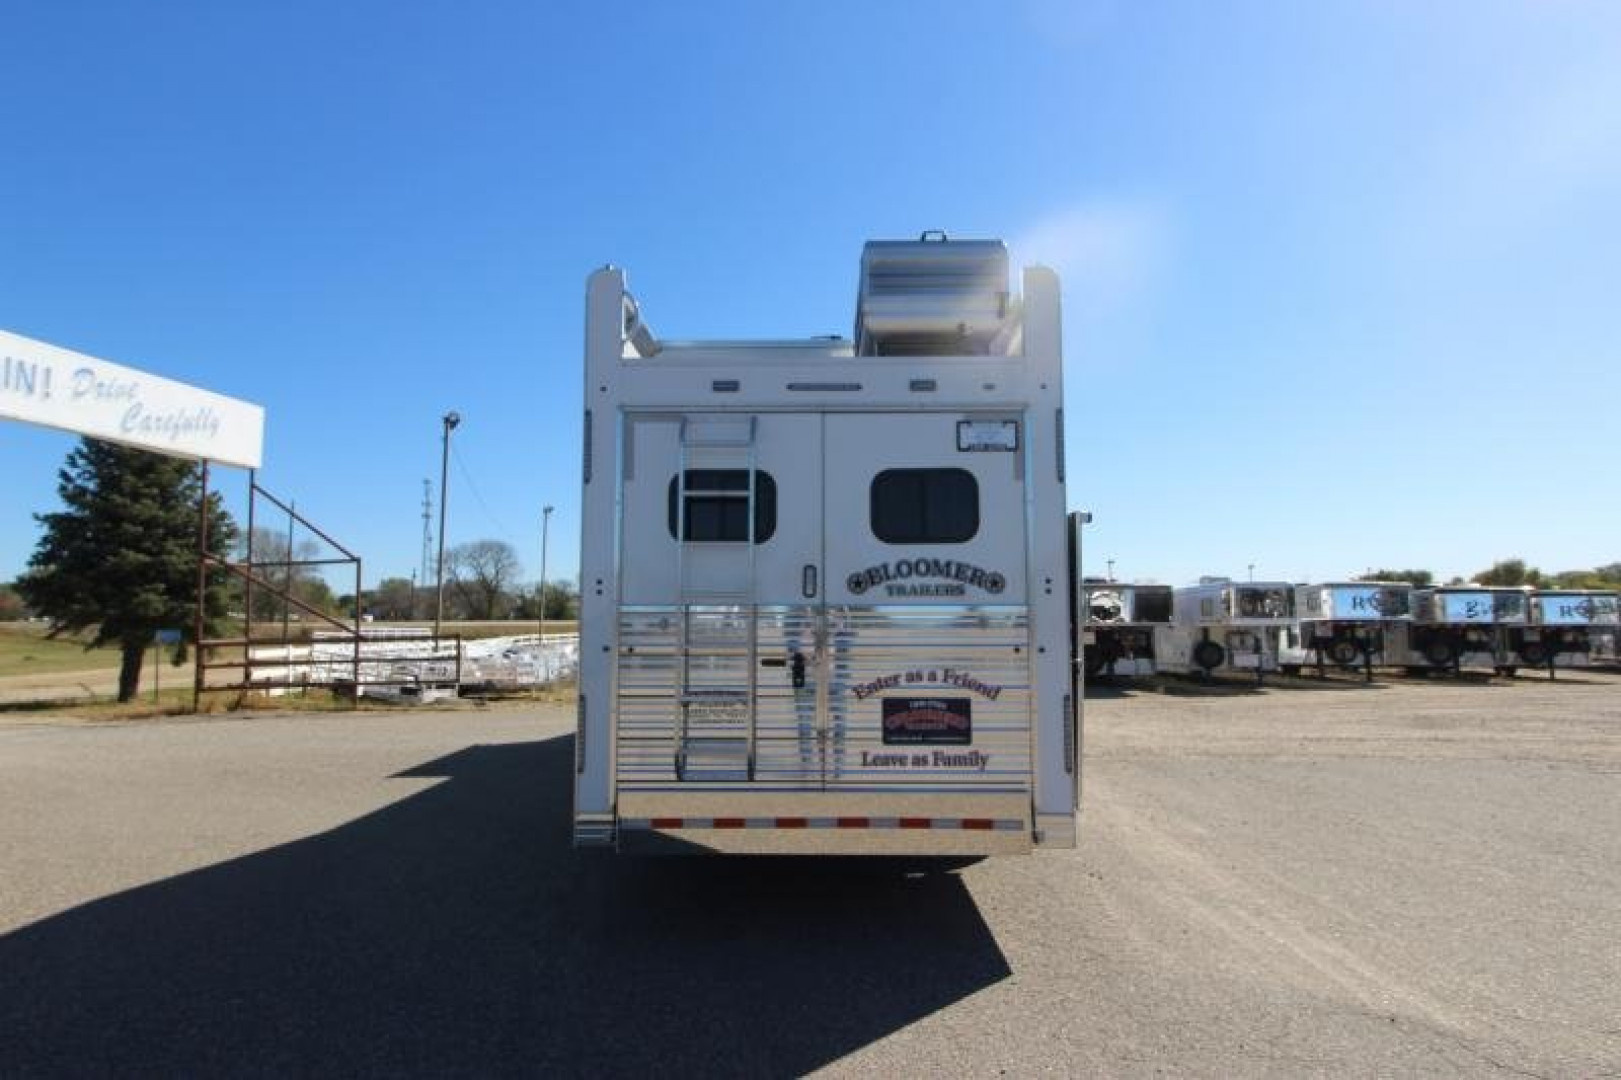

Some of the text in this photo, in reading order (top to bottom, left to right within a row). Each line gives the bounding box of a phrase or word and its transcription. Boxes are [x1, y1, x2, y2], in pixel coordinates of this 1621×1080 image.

[72, 367, 140, 402] Drive
[121, 402, 220, 441] Carefully
[864, 558, 988, 589] BLOOMER
[885, 583, 966, 597] TRAILERS
[851, 673, 901, 700] Enter
[906, 670, 925, 683] as
[942, 667, 1002, 700] Friend
[861, 750, 989, 772] Leave as Family
